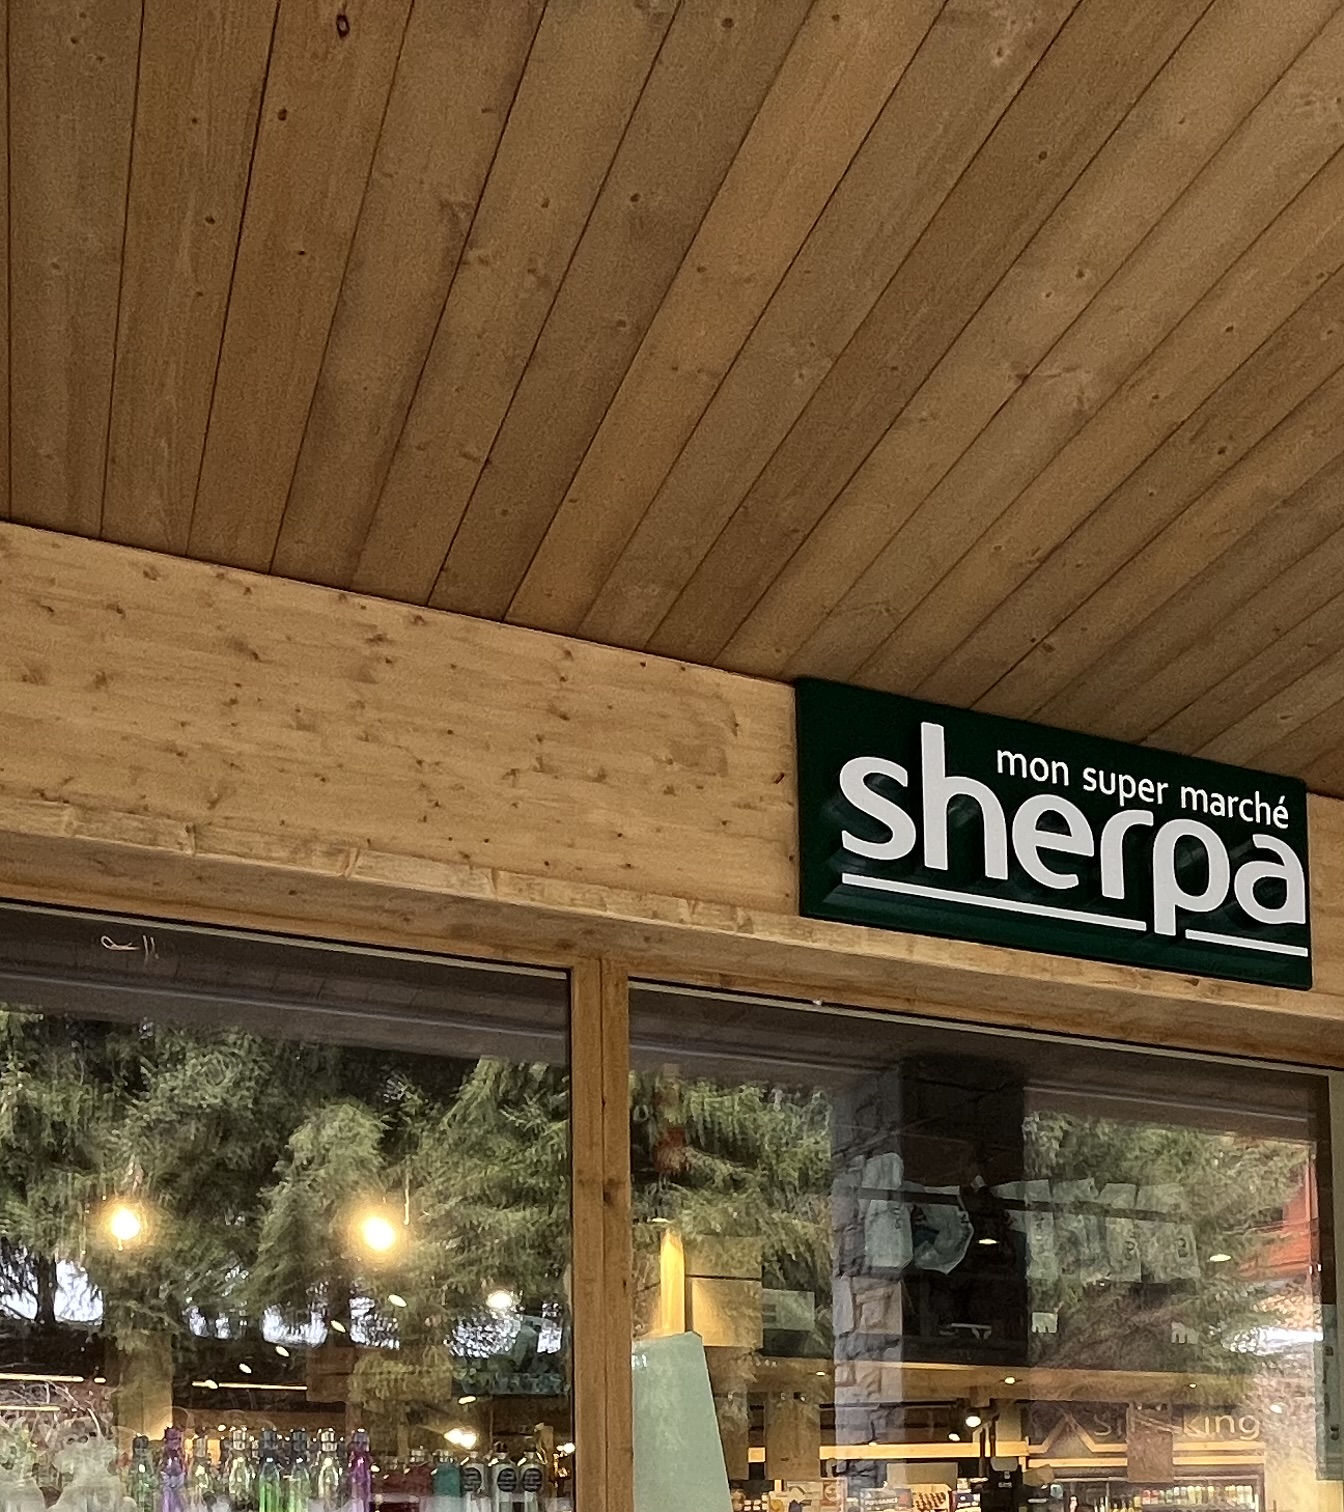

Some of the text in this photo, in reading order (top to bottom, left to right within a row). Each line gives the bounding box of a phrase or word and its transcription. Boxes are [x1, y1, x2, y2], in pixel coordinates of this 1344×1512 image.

[838, 721, 1307, 937] sherpa
[996, 748, 1290, 831] mon super marché
